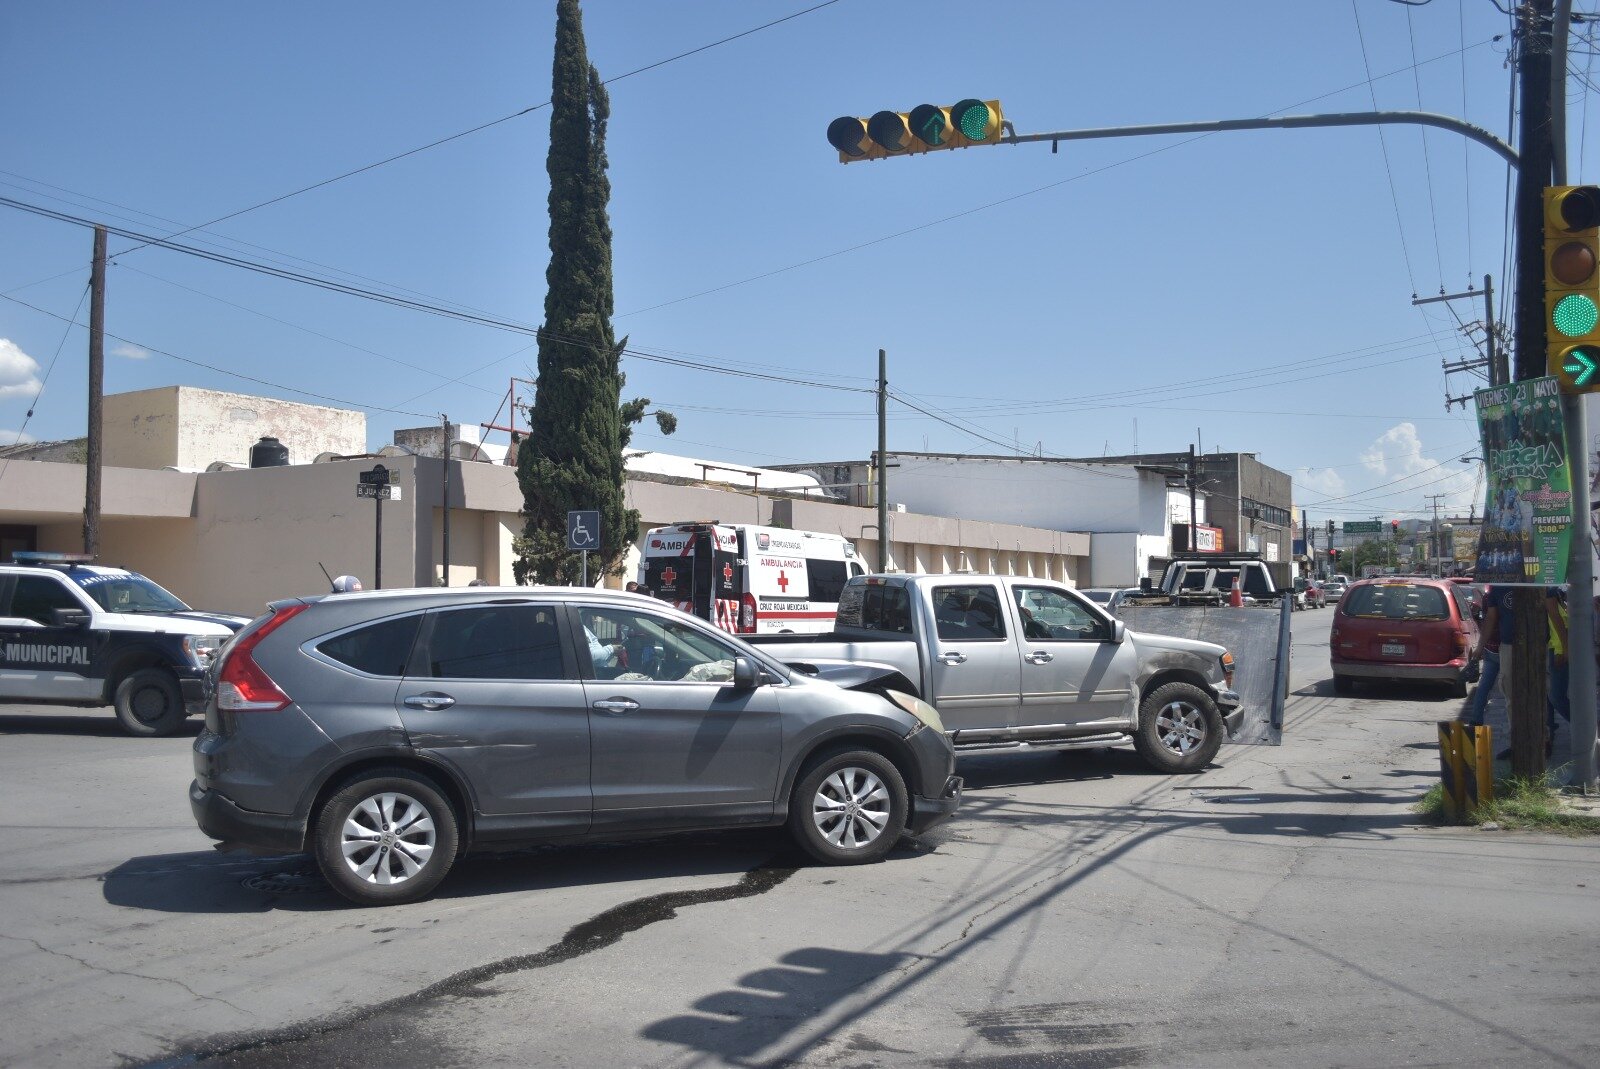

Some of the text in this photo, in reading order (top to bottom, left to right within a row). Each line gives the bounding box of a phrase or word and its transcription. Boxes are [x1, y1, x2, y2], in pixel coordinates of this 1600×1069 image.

[1476, 380, 1558, 408] VIERNES 23 MAYO
[1532, 516, 1571, 525] PREVENTA
[760, 558, 804, 569] AMBULANCIA
[759, 602, 809, 611] CRUZ ROJA MEXICANA
[6, 643, 91, 665] MUNICIPAL
